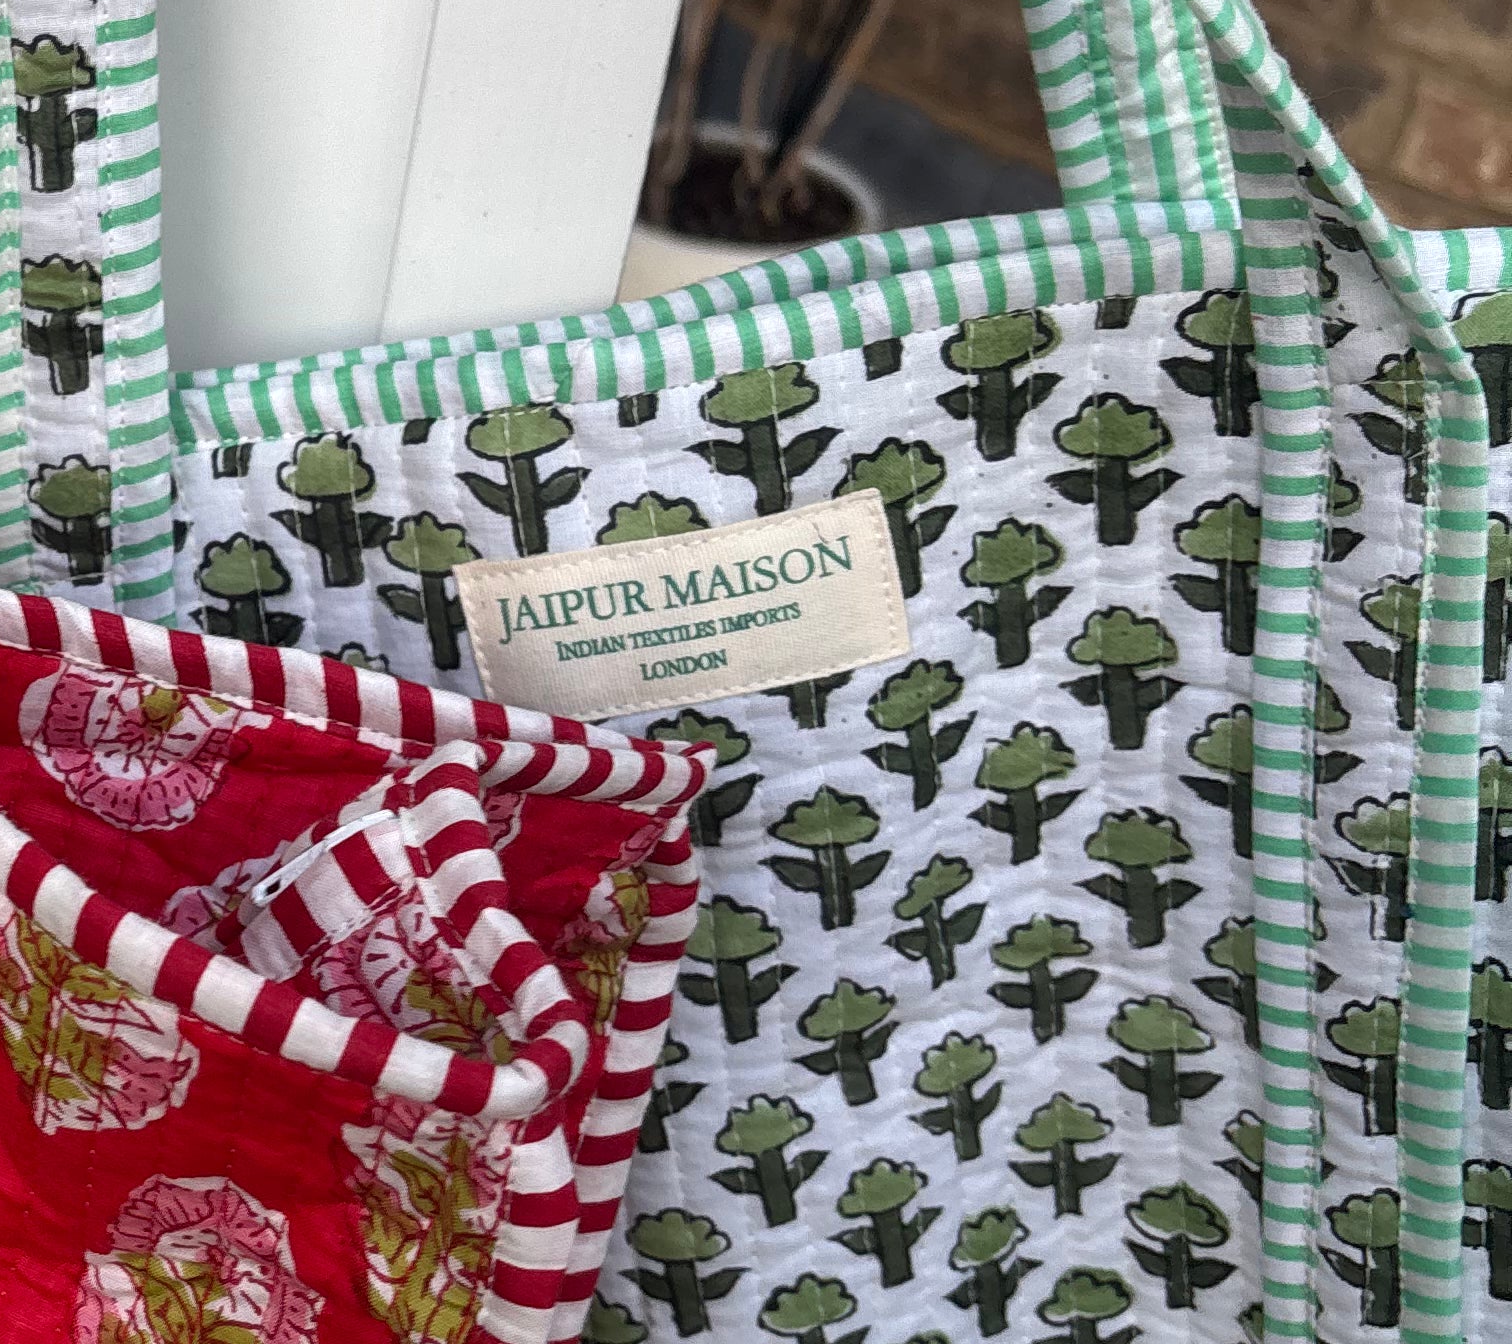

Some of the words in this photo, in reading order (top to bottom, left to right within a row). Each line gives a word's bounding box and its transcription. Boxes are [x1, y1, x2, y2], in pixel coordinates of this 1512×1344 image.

[496, 579, 655, 645] JAIPUR
[659, 535, 855, 611] MAISON
[555, 634, 626, 662] INDIAN
[628, 619, 717, 649] TEXTILES
[719, 601, 802, 634] IMPORTS
[639, 649, 729, 681] LONDON
